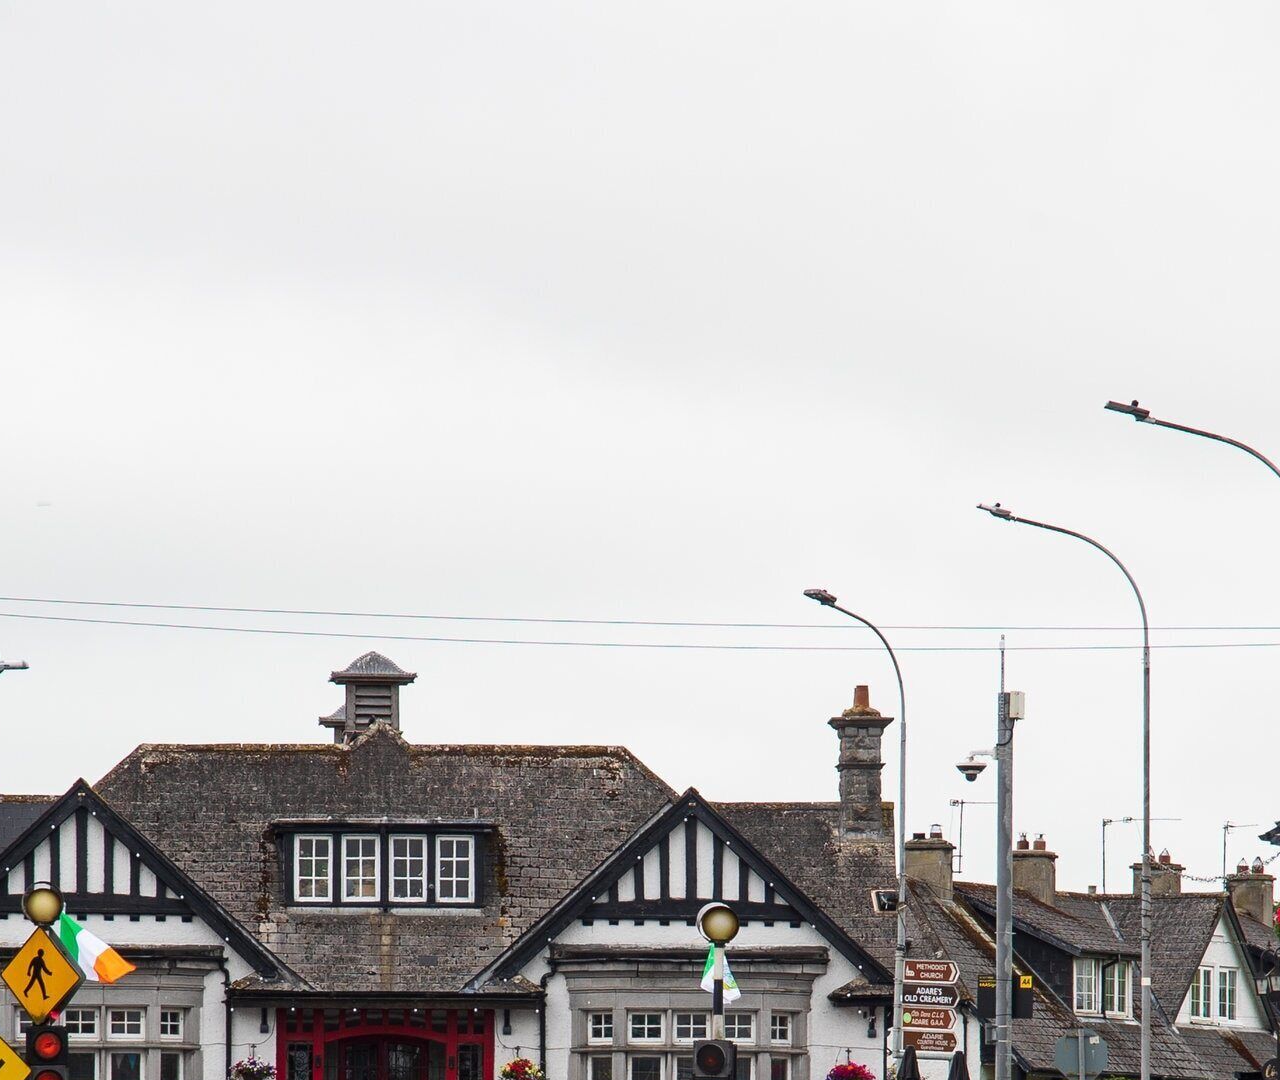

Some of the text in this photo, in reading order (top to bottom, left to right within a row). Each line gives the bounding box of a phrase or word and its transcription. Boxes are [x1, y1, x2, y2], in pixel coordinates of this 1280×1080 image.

[916, 963, 948, 971] METHODIST
[920, 971, 944, 979] CHURCH
[916, 986, 943, 996] ADARE'S
[904, 994, 953, 1004] OLD CREAMERY
